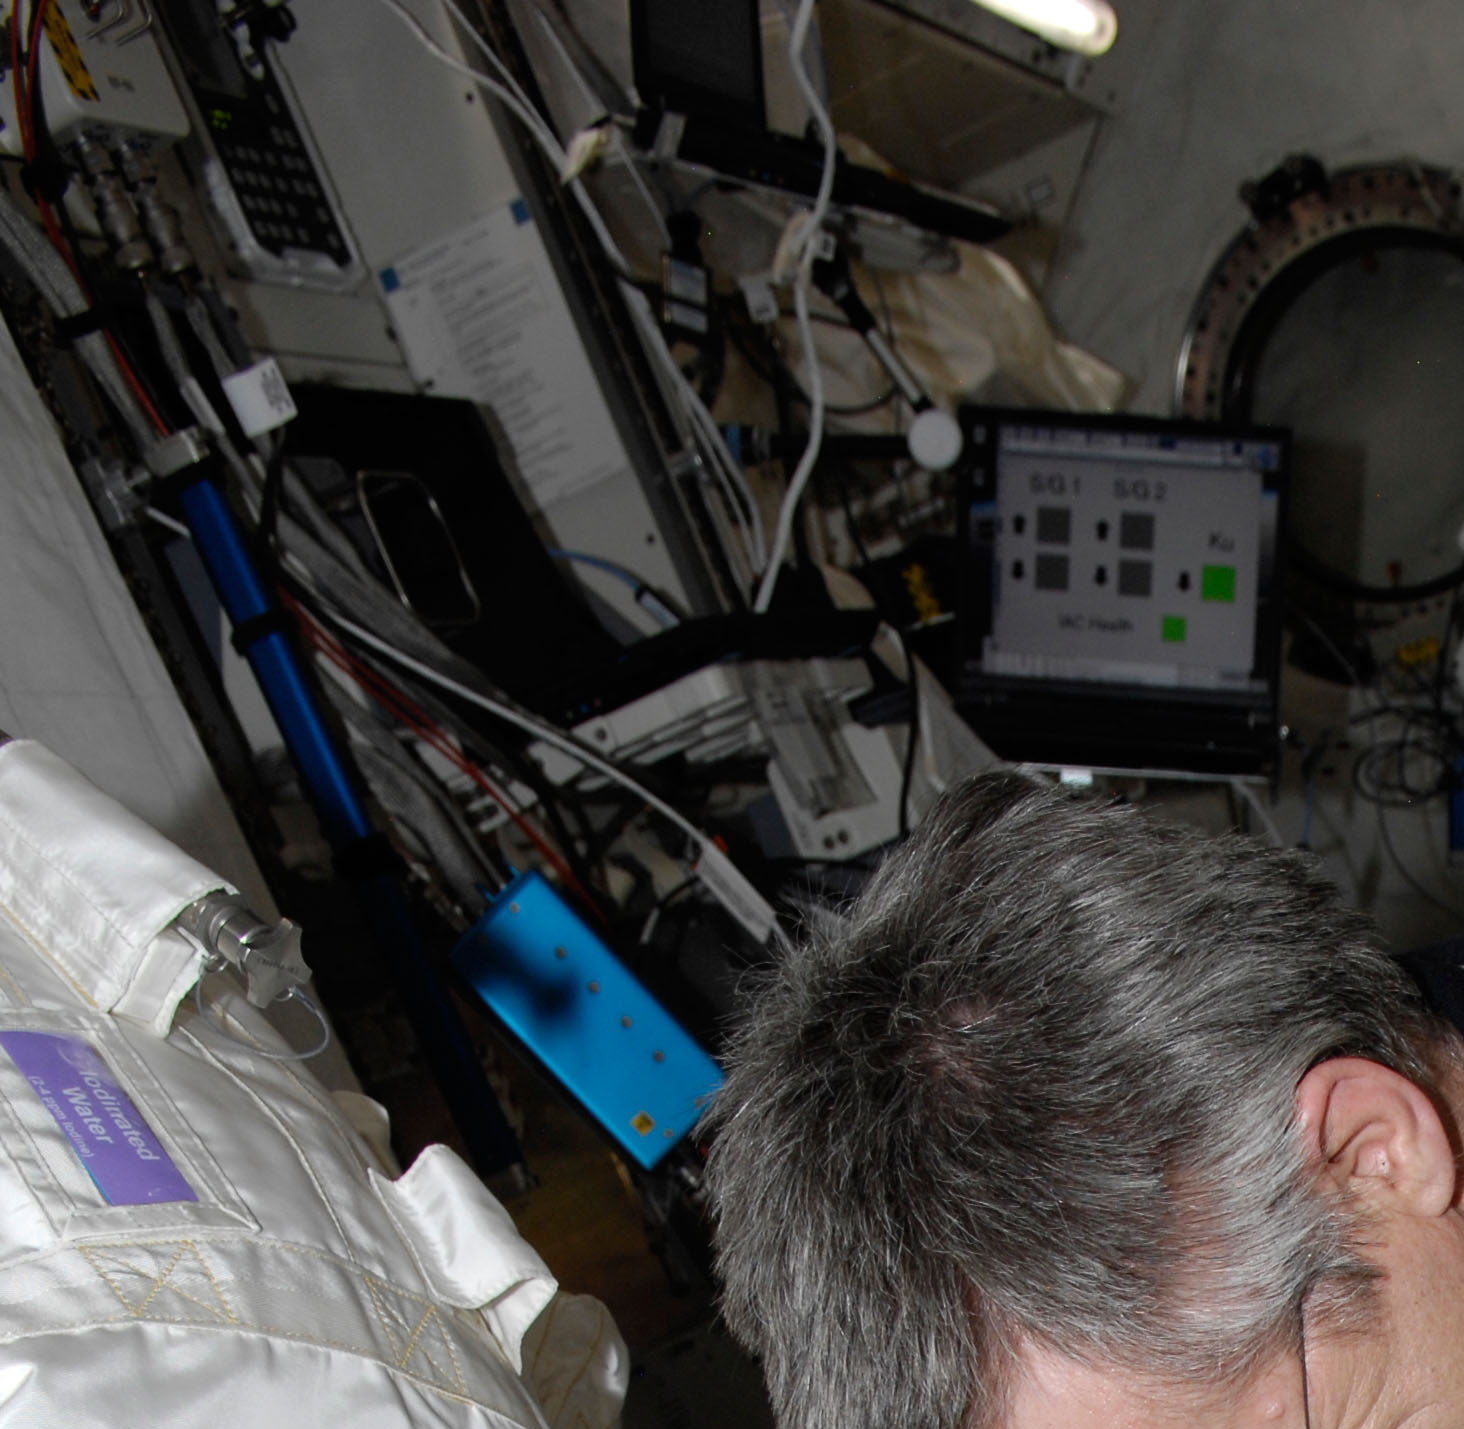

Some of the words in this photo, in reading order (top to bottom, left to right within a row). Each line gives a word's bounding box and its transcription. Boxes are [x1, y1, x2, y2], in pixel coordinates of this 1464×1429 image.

[1155, 481, 1168, 501] 2
[1208, 532, 1235, 551] Ku
[41, 1095, 66, 1119] ppm
[61, 1087, 114, 1141] Water
[78, 1071, 160, 1160] Iodinated
